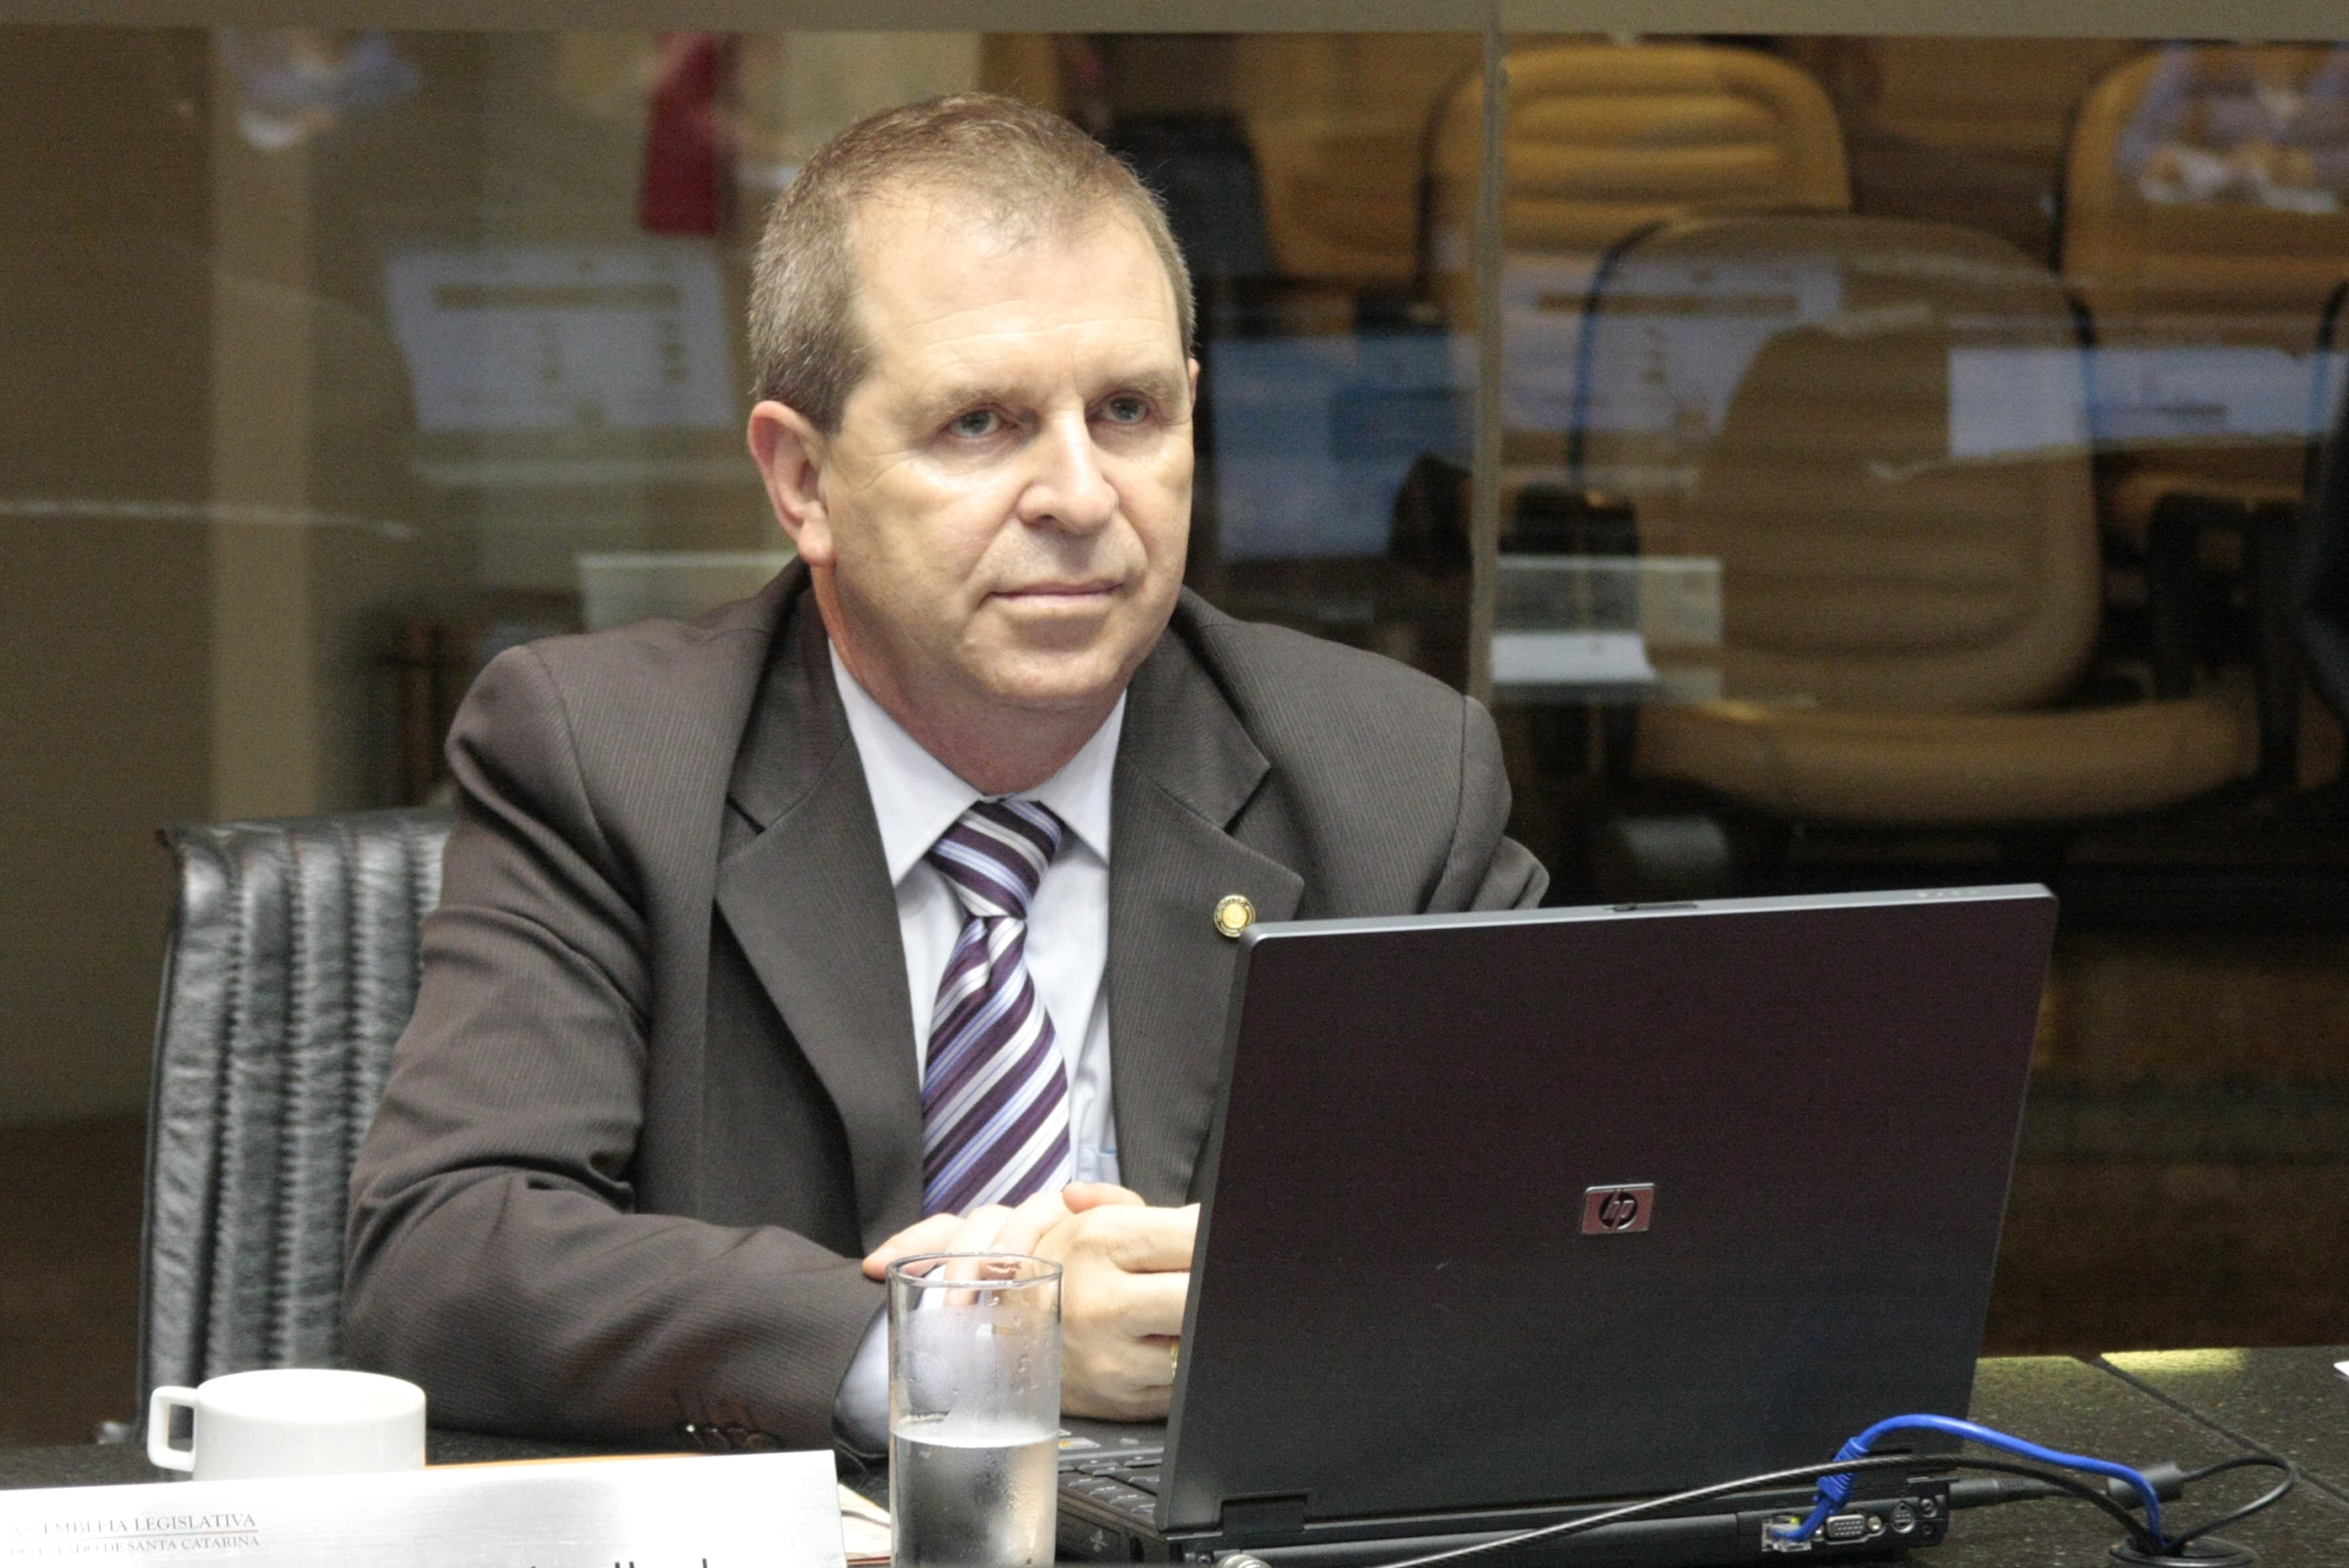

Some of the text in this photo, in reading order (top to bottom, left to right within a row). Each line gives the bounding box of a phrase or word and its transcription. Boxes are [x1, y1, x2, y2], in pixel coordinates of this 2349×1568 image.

[1601, 1189, 1636, 1231] hp
[134, 1513, 257, 1532] LEGISLATIVA
[103, 1541, 124, 1554] DE
[128, 1539, 178, 1553] SANTA
[181, 1535, 260, 1550] CATARINA
